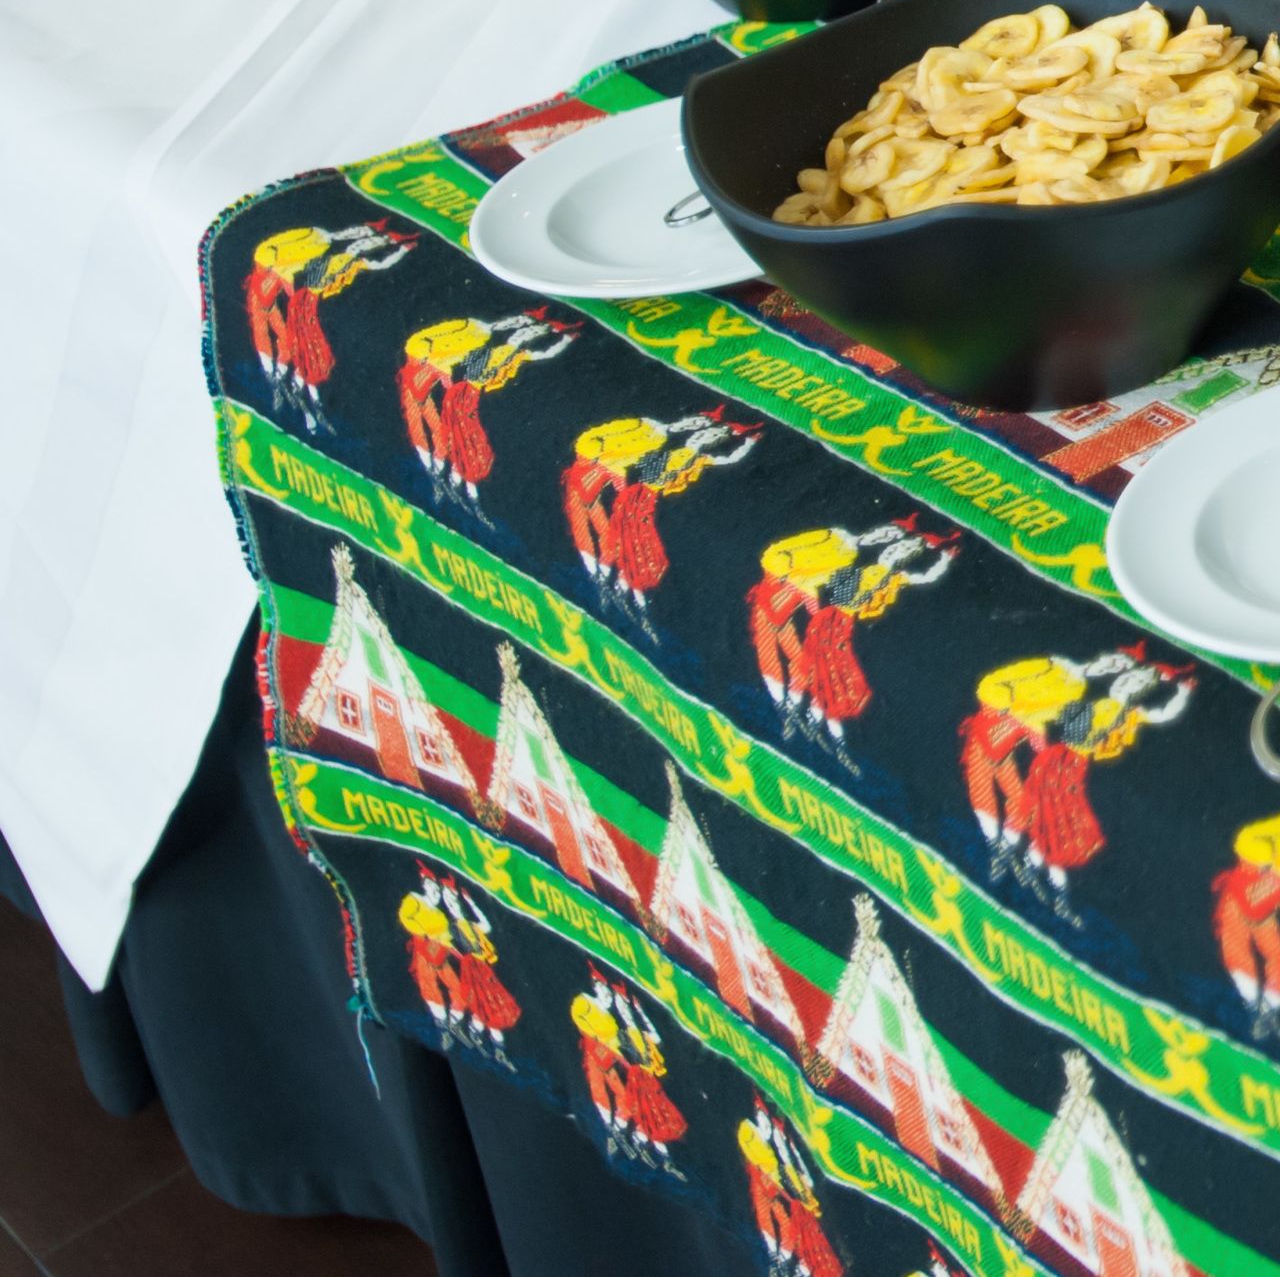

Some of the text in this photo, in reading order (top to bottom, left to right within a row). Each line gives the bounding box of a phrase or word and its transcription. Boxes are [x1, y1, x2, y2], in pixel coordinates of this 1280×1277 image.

[720, 347, 868, 422] MADEIRA
[911, 447, 1070, 538] MADEIRA
[341, 787, 468, 858] MADEIRA
[530, 877, 637, 967] MADEIRA
[856, 1141, 982, 1263] MADEIRA
[432, 540, 544, 635] MADEIRA
[982, 920, 1131, 1055] MADEIRA
